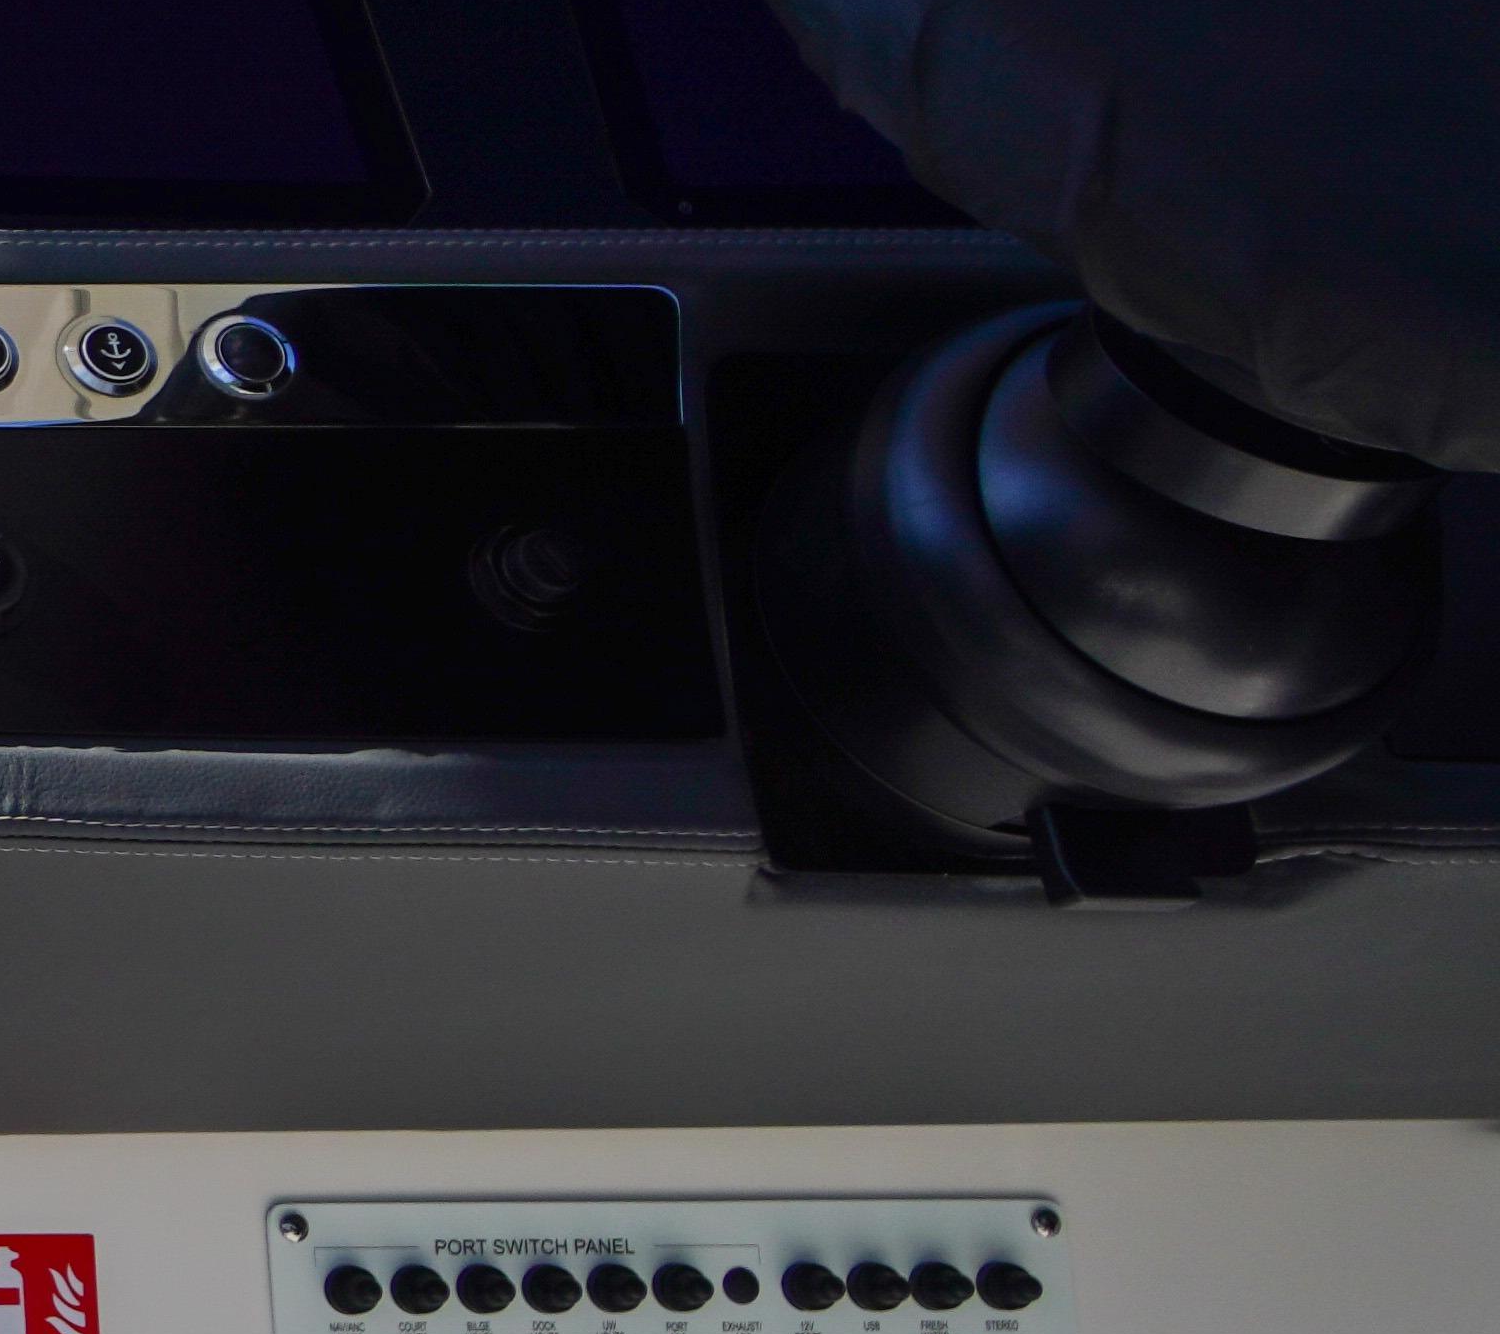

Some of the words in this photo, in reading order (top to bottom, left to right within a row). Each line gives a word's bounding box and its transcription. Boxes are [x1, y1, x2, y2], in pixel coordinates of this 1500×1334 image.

[434, 1238, 486, 1256] PORT
[493, 1238, 568, 1255] SWITCH
[574, 1238, 635, 1255] PANEL
[399, 1321, 428, 1331] COURT
[533, 1321, 556, 1331] DOCK
[666, 1321, 688, 1331] PORT
[801, 1321, 814, 1331] 12V
[864, 1321, 880, 1331] USB
[920, 1320, 948, 1329] FRESH
[985, 1320, 1019, 1331] STEREO
